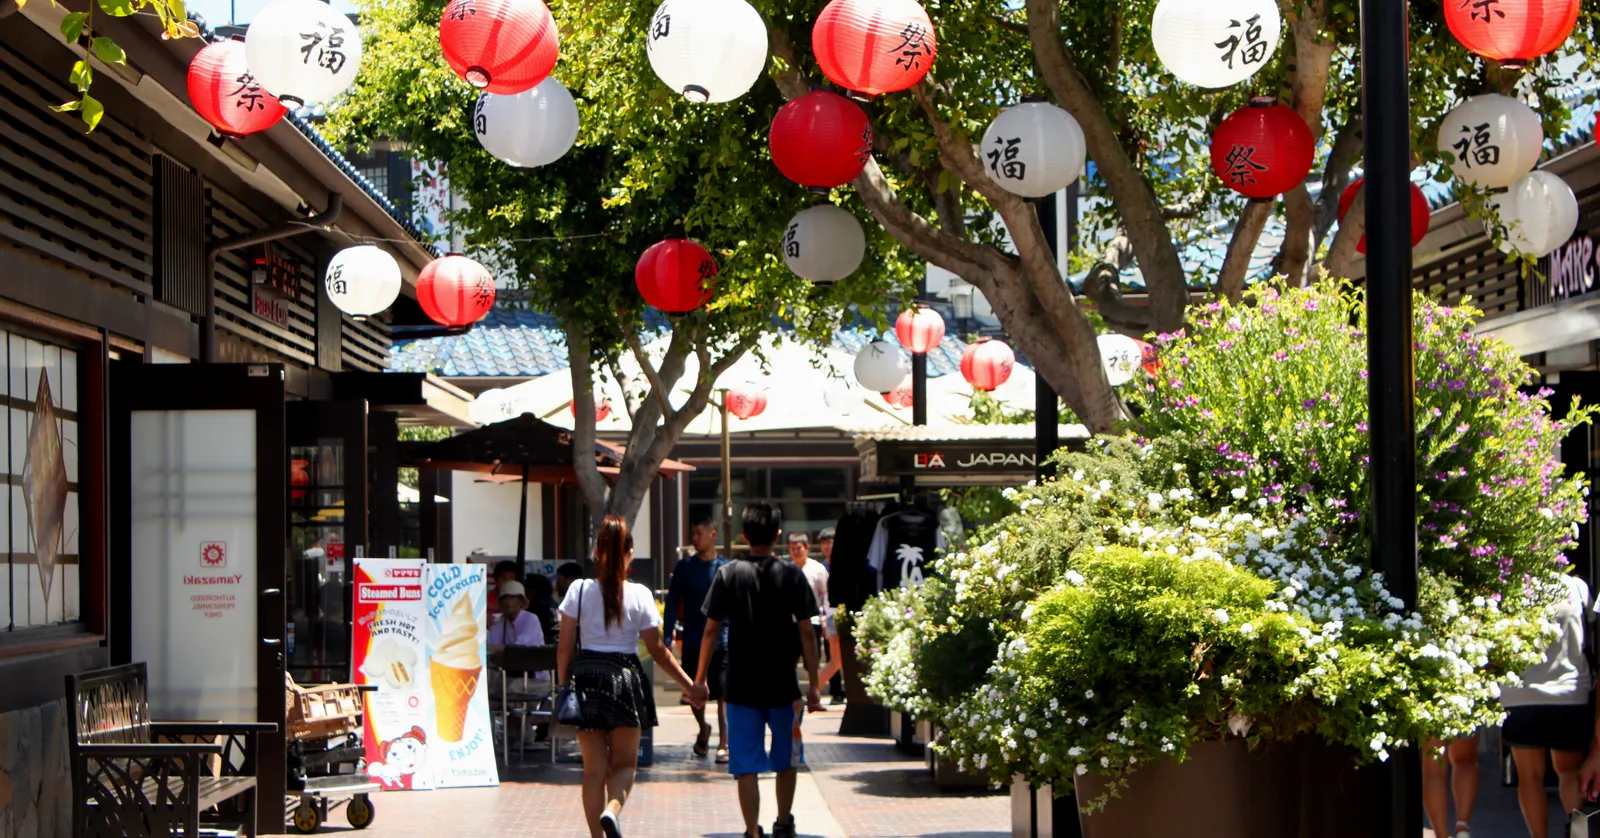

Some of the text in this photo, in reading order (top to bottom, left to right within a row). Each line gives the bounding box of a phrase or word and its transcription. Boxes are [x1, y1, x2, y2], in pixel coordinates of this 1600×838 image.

[299, 21, 346, 74] 福
[888, 22, 932, 71] 祭
[1213, 14, 1268, 70] 福
[987, 136, 1026, 180] 福
[1453, 123, 1500, 169] 福
[1223, 145, 1267, 187] 祭
[326, 264, 347, 295] 福
[472, 276, 496, 308] 祭
[957, 452, 1036, 468] JAPAN
[361, 587, 421, 599] Steamed Buns
[428, 565, 462, 599] COLD
[428, 573, 481, 620] Ice Cream
[368, 619, 416, 632] FRESH HOT
[370, 627, 420, 645] AND TASTY!
